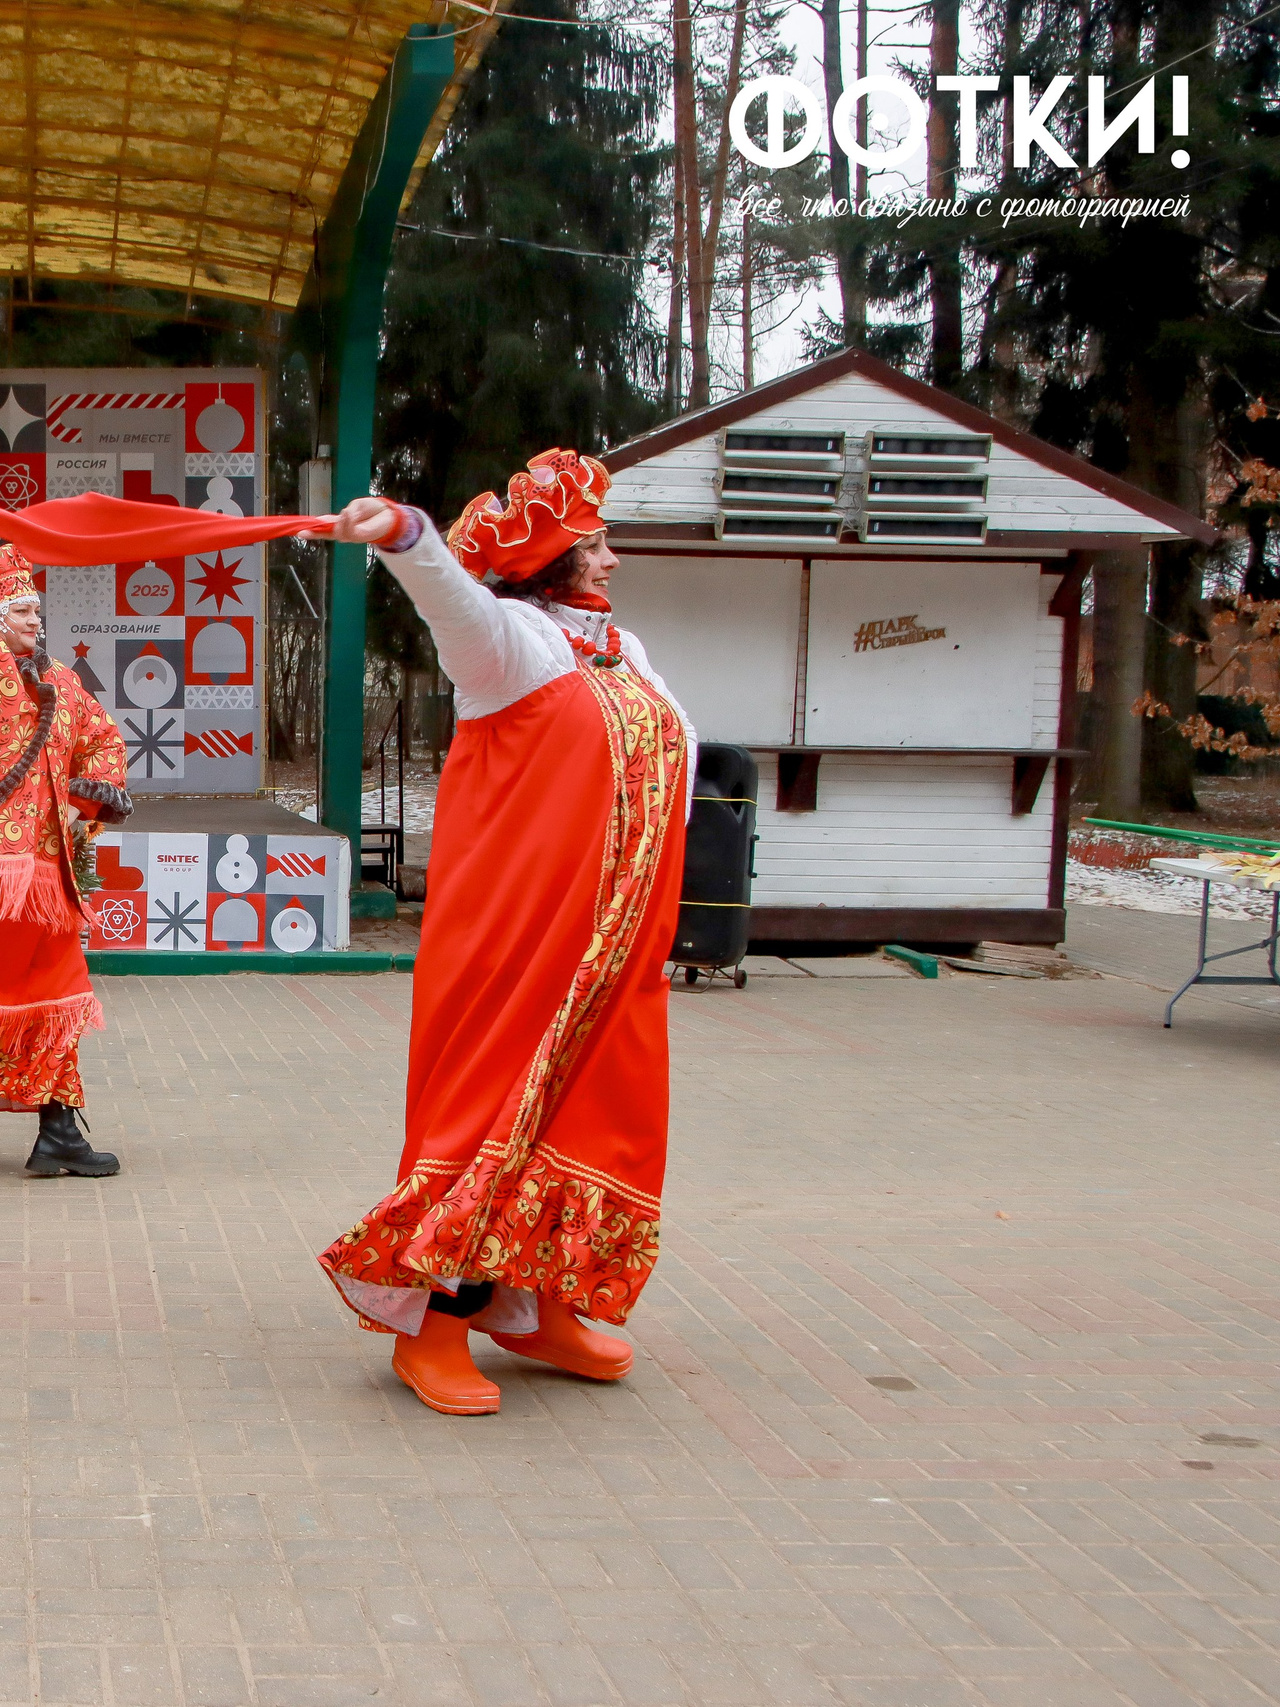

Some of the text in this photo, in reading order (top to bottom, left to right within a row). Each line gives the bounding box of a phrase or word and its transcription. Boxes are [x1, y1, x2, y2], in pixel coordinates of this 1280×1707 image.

[99, 433, 172, 444] МЫ ВМЕСТЕ
[56, 459, 107, 470] РОССИЯ
[131, 584, 170, 597] 2025
[70, 624, 161, 634] ОБРАЗОВАНИЕ
[157, 854, 199, 863] SINTEC
